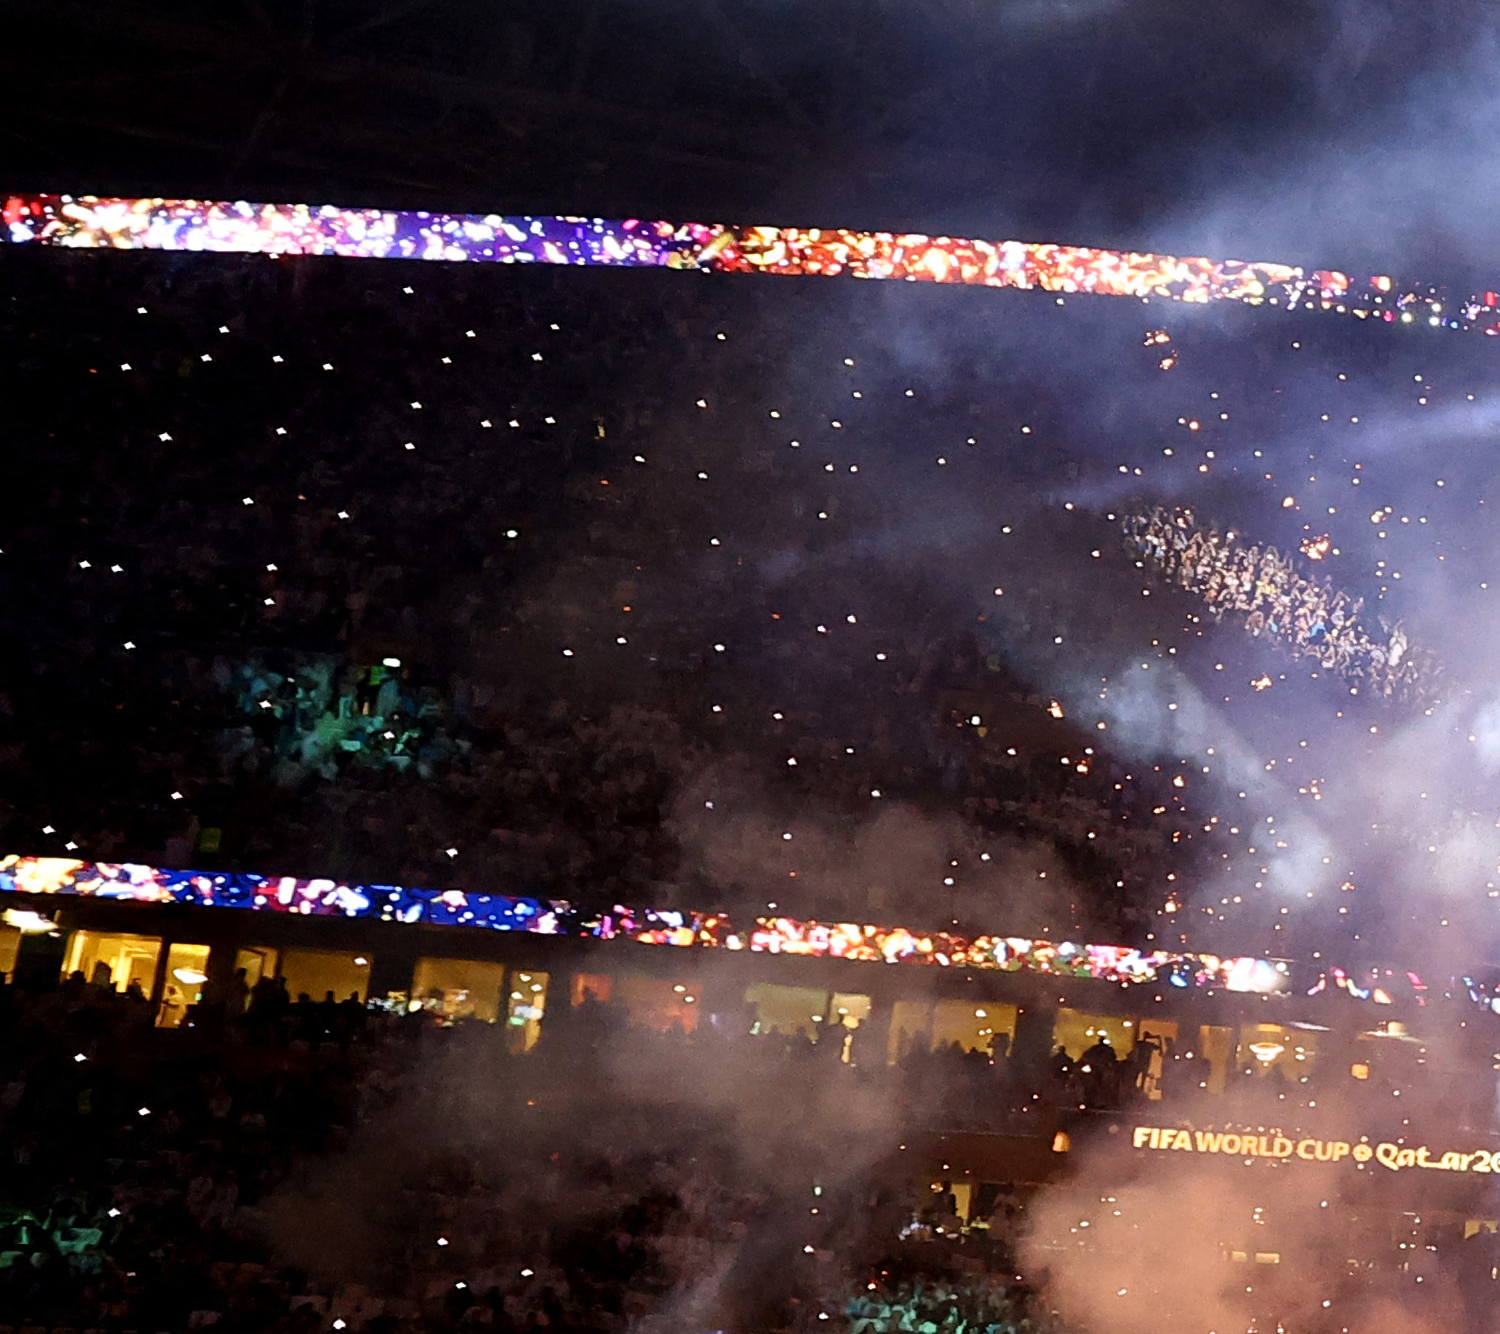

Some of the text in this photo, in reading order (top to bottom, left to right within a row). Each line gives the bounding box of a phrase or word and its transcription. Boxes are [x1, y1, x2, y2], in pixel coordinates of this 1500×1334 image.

[1133, 1126, 1193, 1152] FIFA
[1195, 1131, 1294, 1159] WORLD
[1297, 1139, 1350, 1162] CUP
